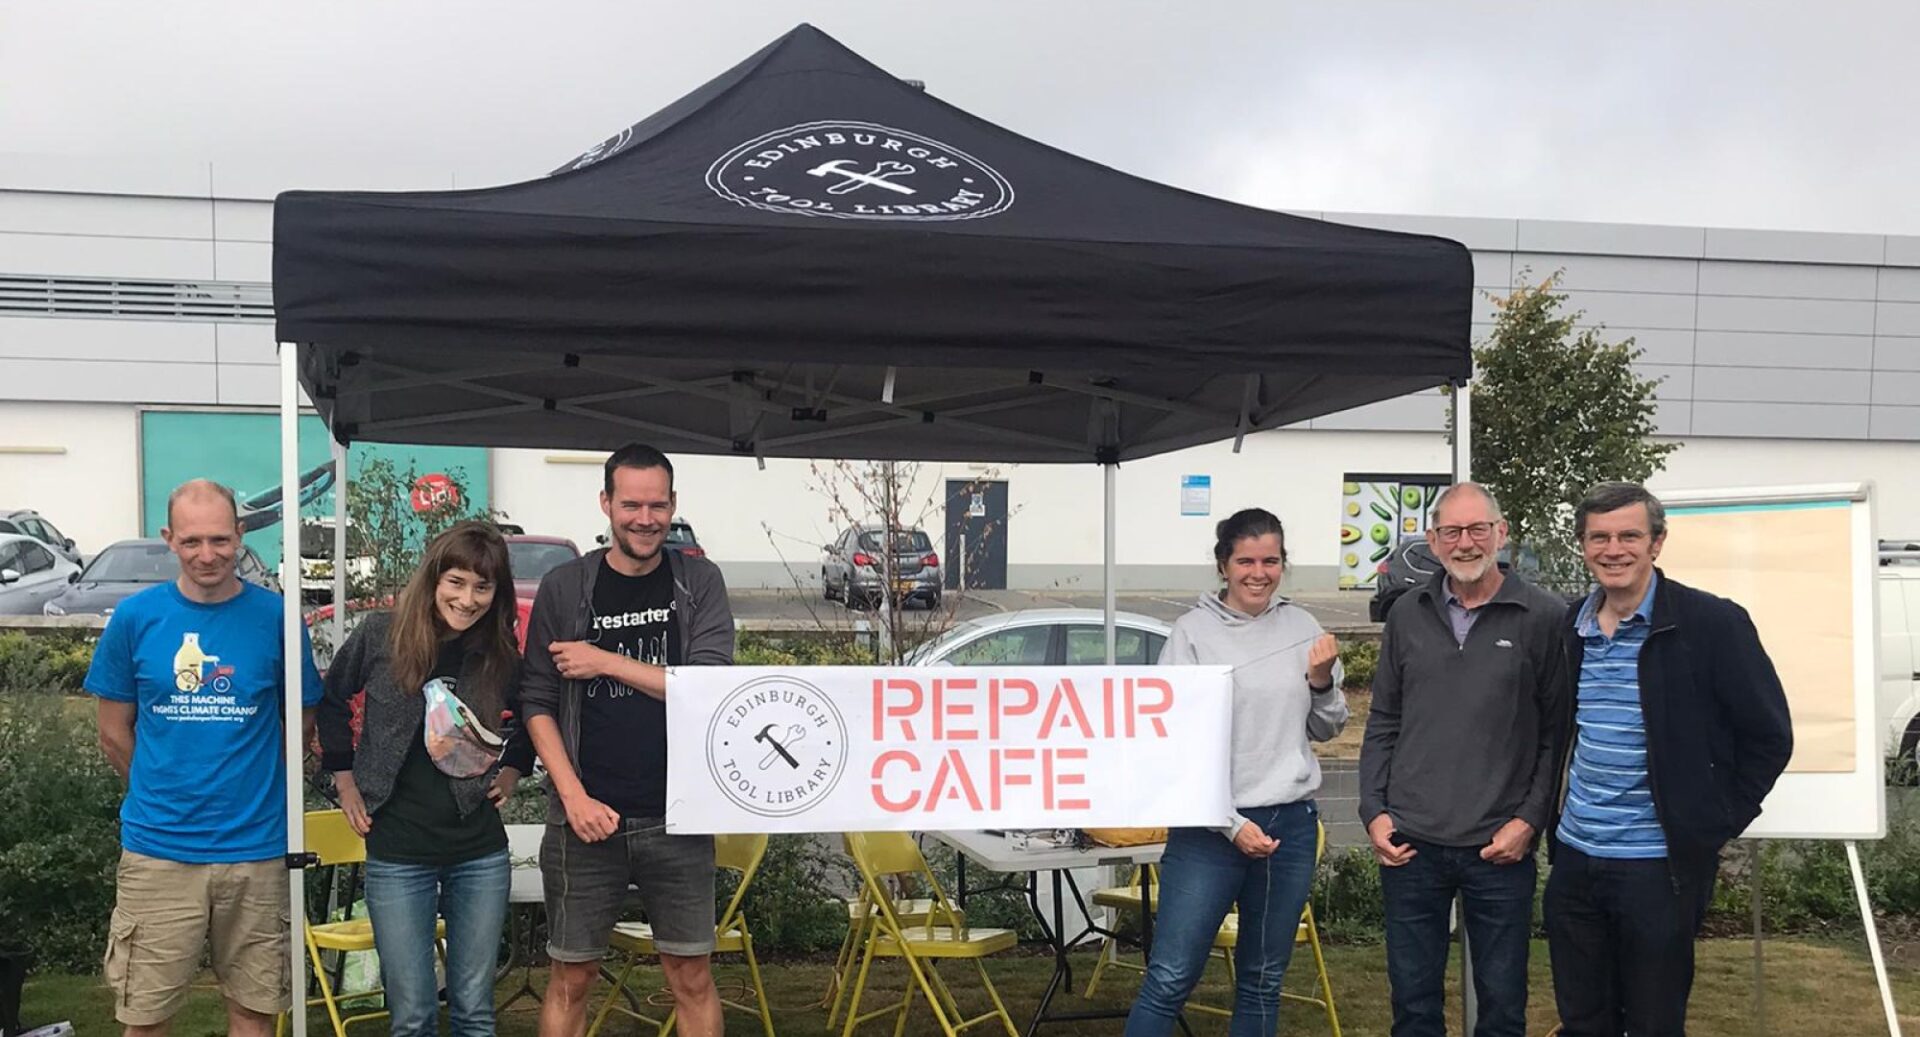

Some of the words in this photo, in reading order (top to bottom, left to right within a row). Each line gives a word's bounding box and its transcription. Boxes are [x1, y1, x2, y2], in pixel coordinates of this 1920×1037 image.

[744, 132, 957, 169] EDINBURGH
[750, 187, 834, 211] TOOL
[854, 188, 985, 215] LIBRARY
[152, 705, 179, 715] FIGHTS
[179, 705, 220, 715] CLIMATE
[169, 695, 190, 705] THIS
[191, 695, 236, 705] MACHINE
[727, 690, 829, 728] EDINBURGH
[872, 678, 1174, 741] REPAIR
[723, 759, 758, 799] TOOL
[766, 757, 832, 803] LIBRARY
[871, 748, 1091, 812] CAFE
